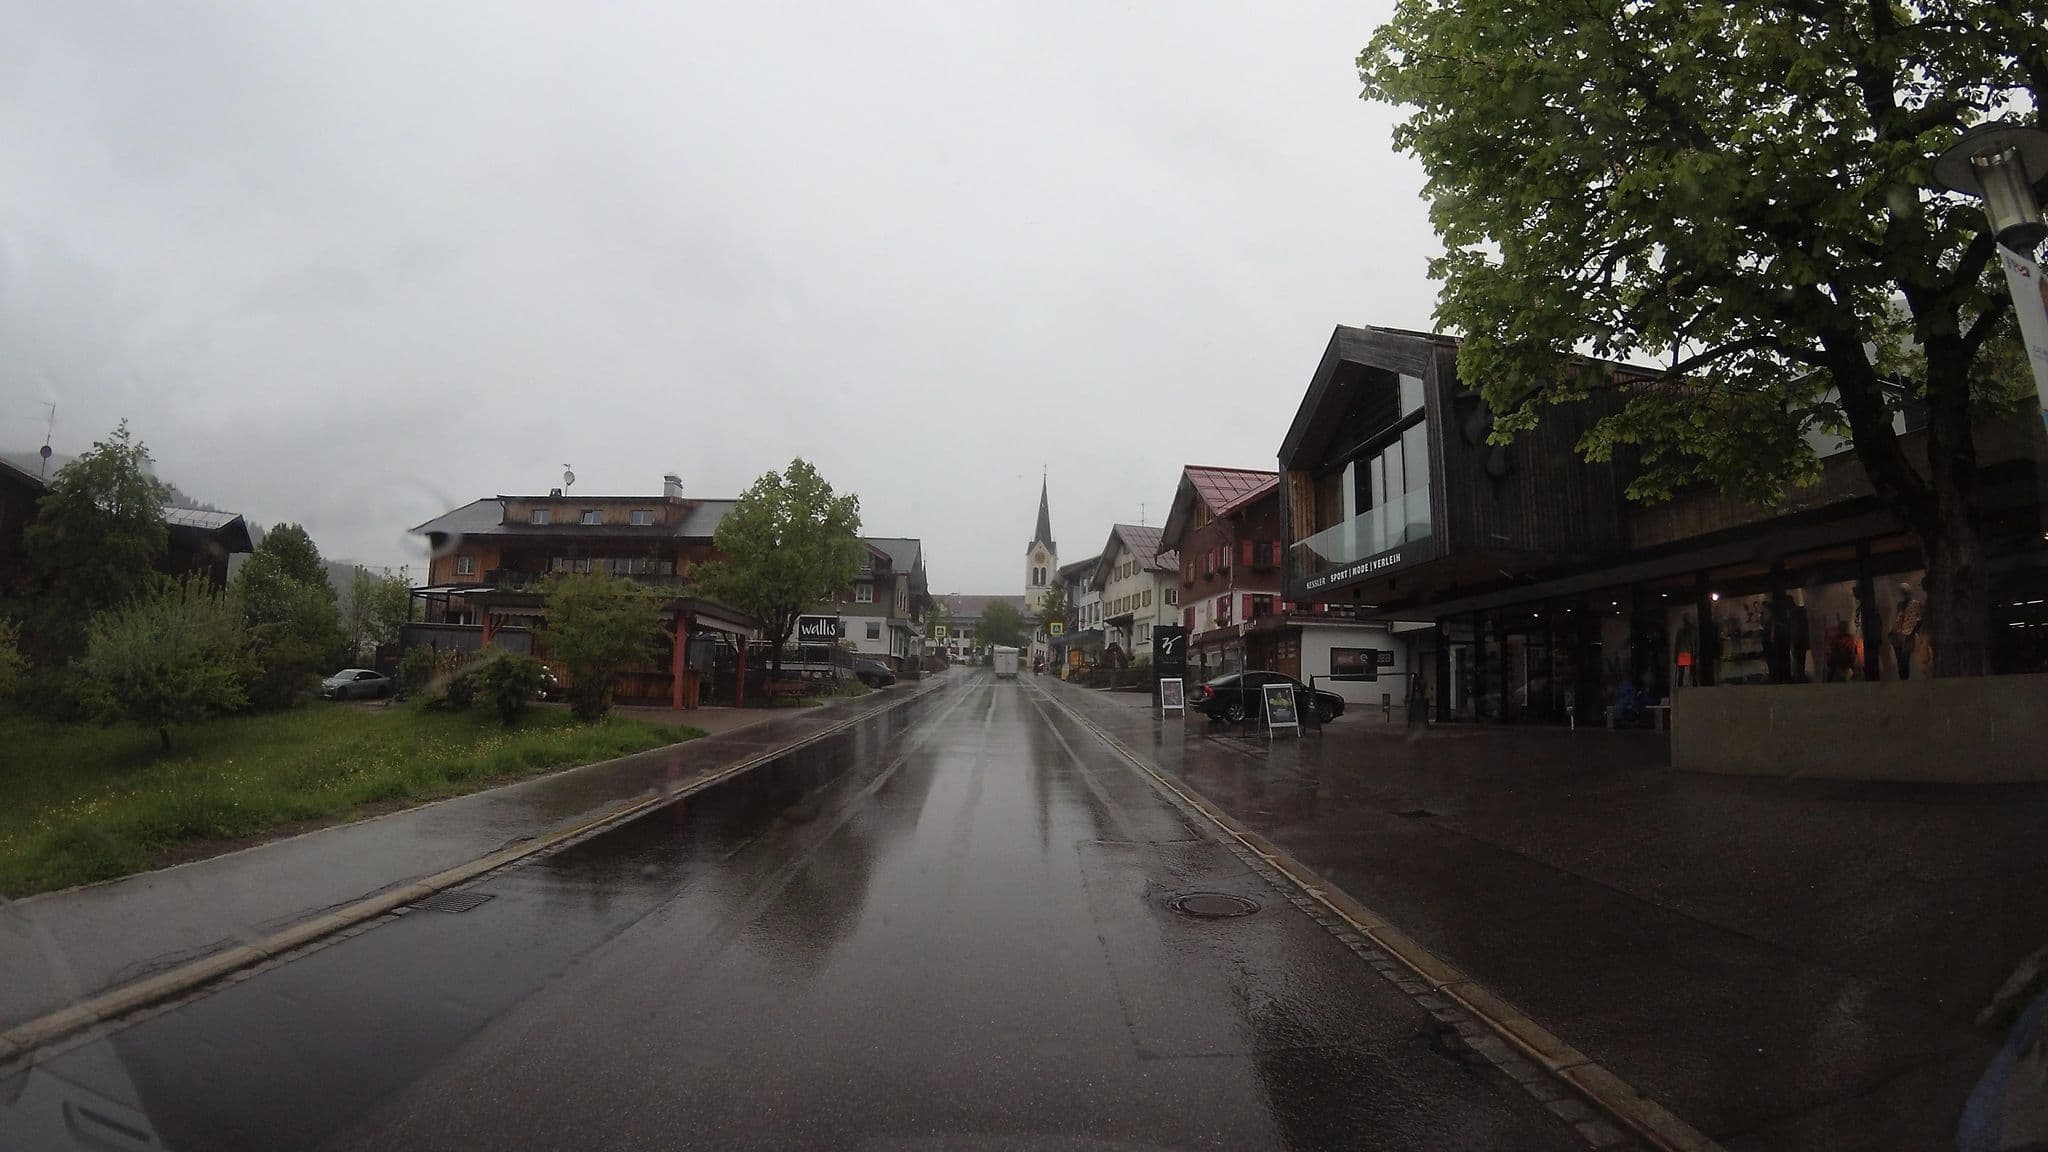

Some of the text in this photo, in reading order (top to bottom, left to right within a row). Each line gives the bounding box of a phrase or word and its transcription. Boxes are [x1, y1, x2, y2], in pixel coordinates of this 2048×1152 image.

[1330, 570, 1348, 582] SPORT
[1352, 563, 1369, 576] MODE
[1373, 553, 1401, 569] VERLEIH
[801, 619, 836, 635] wallis
